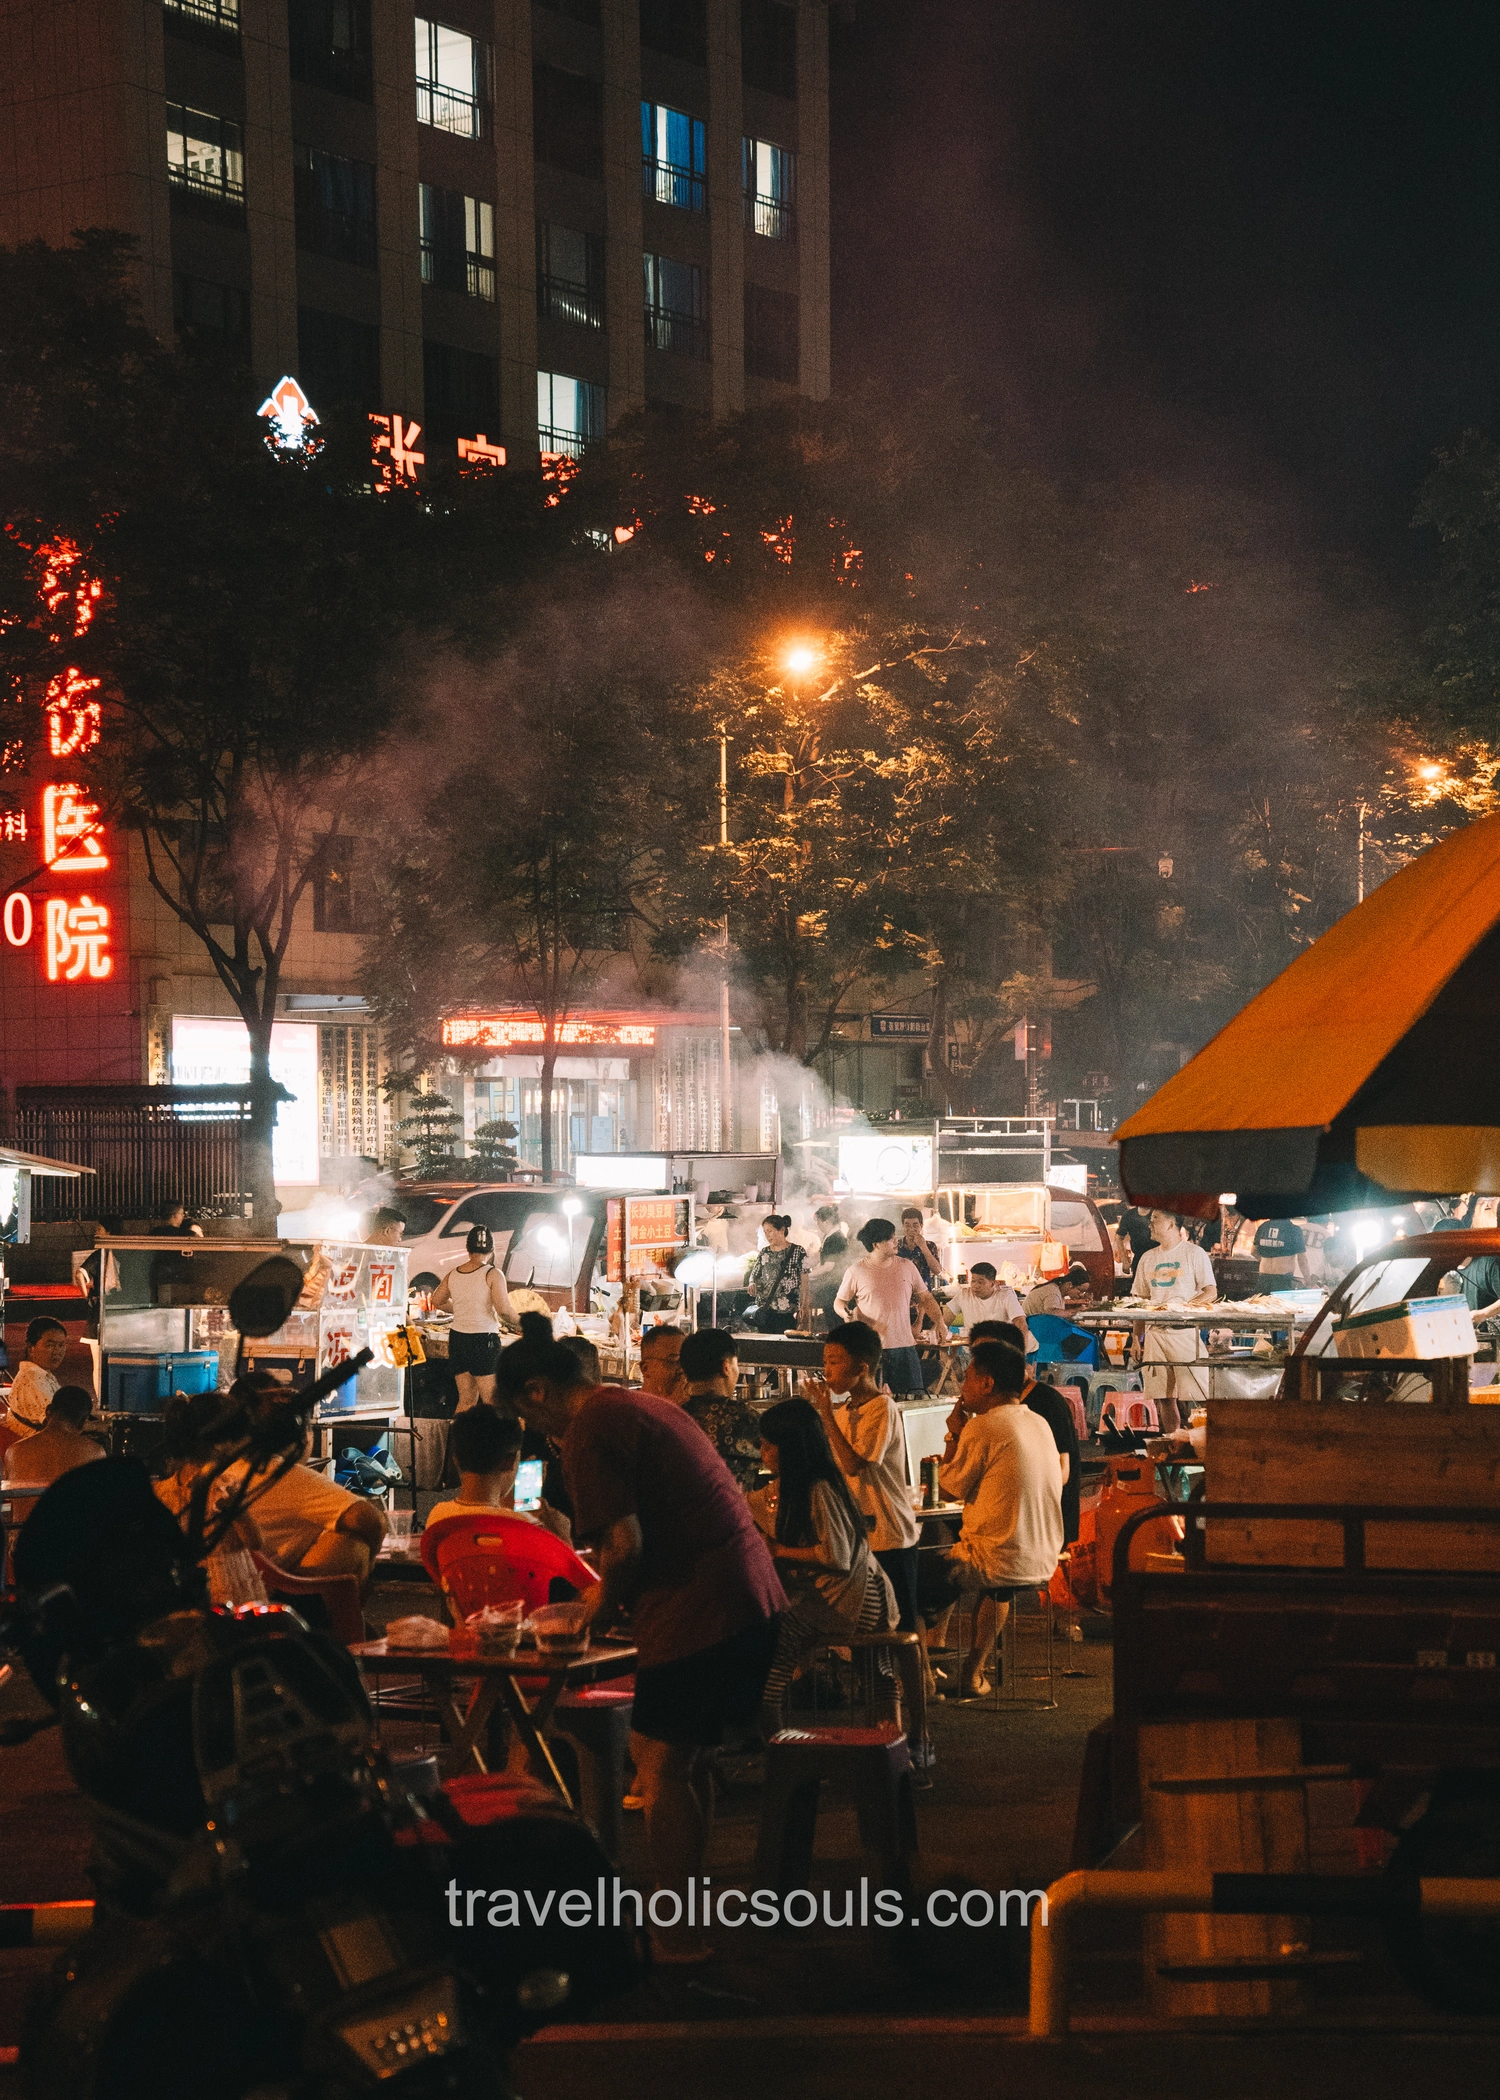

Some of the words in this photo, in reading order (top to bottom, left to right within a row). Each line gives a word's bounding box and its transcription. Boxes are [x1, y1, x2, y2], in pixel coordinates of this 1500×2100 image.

[630, 1203, 672, 1219] 长沙臭豆腐
[630, 1224, 672, 1240] 黄金小土豆
